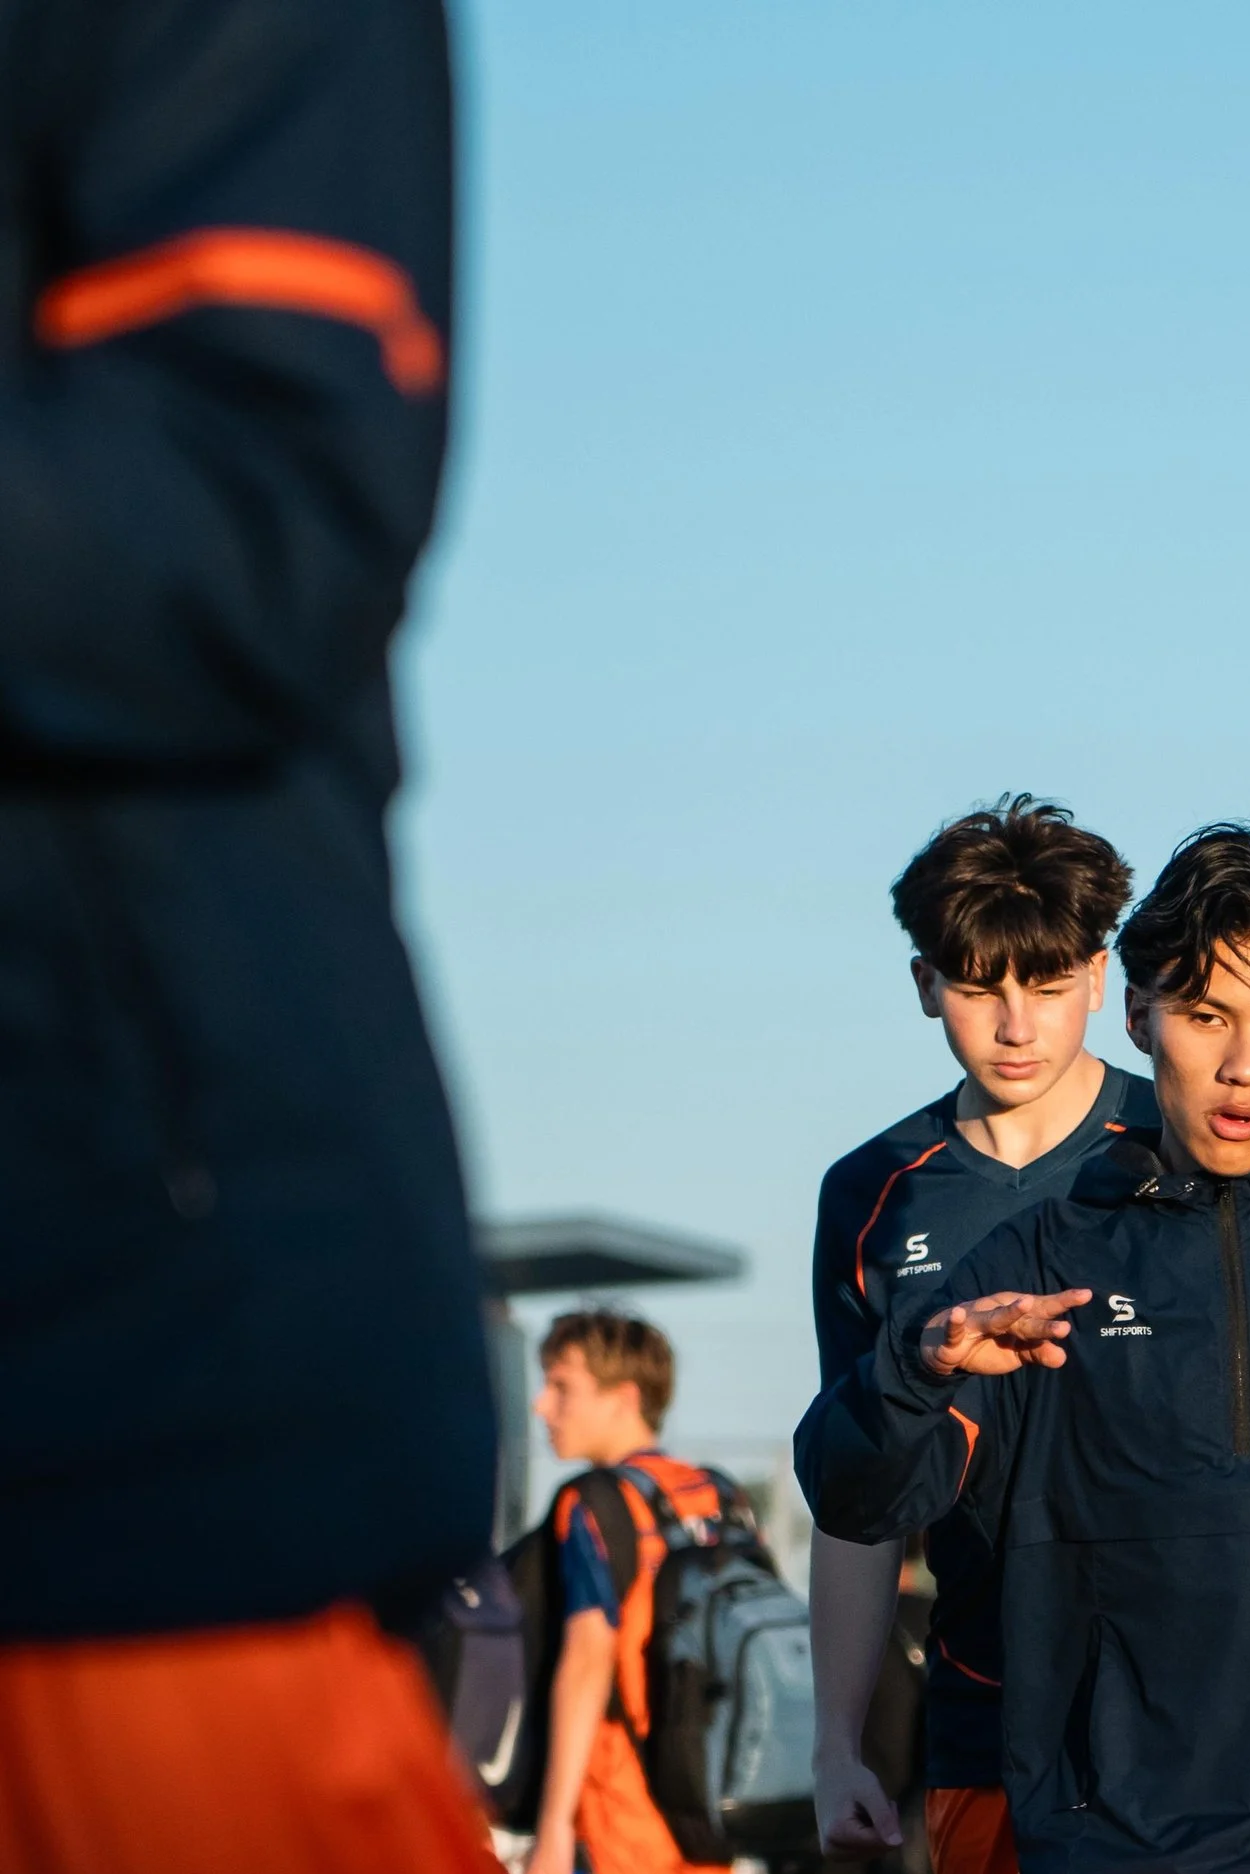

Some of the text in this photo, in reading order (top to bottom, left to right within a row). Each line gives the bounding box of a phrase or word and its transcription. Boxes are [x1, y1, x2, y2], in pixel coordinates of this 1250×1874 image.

[914, 1262, 942, 1274] SPORTS
[1100, 1326, 1153, 1337] SHIFT SPORTS
